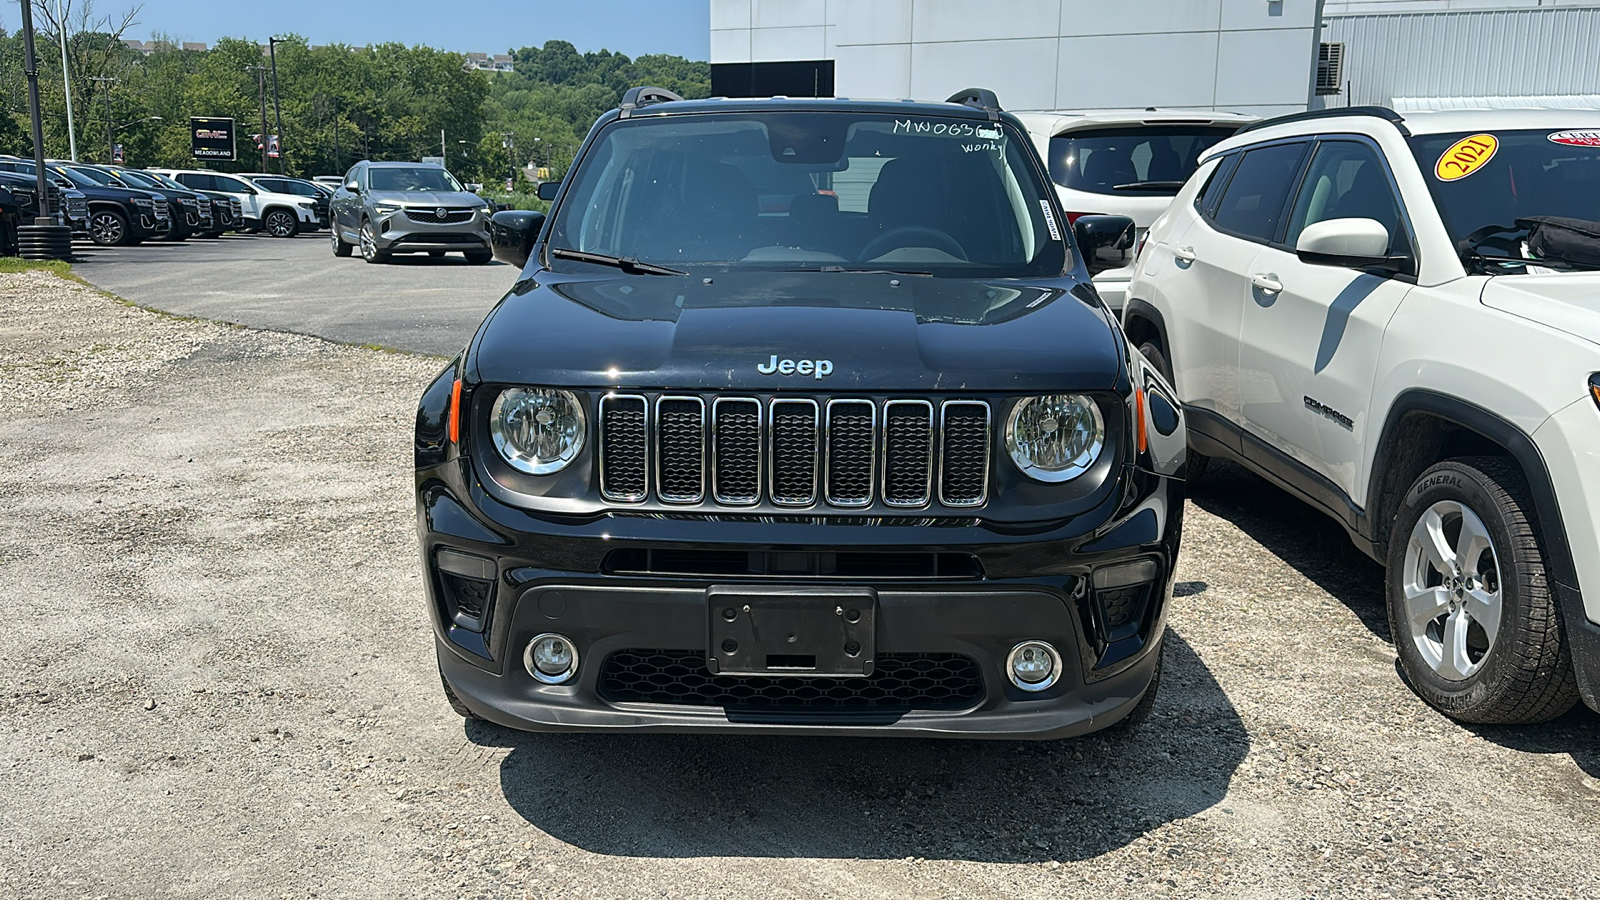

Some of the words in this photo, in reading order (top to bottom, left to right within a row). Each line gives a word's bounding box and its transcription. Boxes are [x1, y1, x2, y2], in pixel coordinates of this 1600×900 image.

[195, 129, 228, 139] GMC
[1445, 139, 1492, 173] 2021
[757, 355, 834, 381] Jeep
[1303, 395, 1355, 429] COMPASS
[1417, 475, 1463, 495] GENERAL
